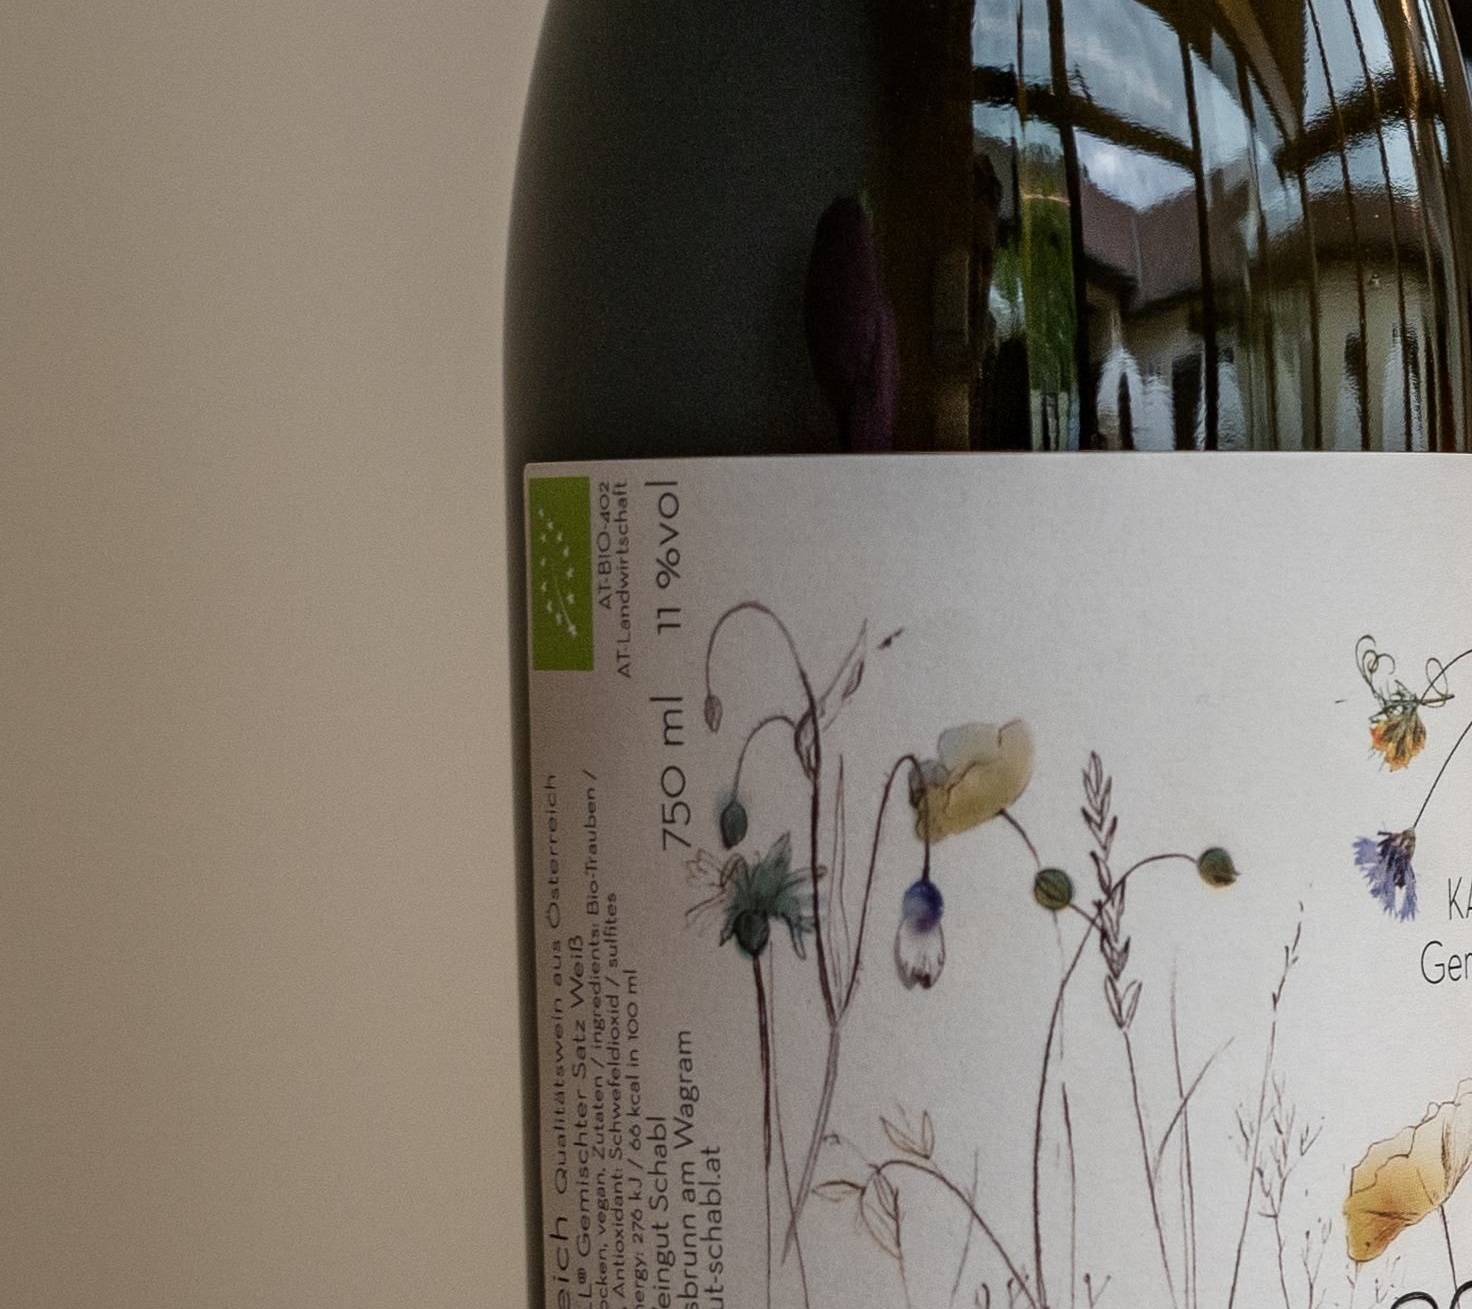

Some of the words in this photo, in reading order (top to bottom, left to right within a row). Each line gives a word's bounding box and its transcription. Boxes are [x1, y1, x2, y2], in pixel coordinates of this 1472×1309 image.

[597, 480, 612, 610] AT-BIO-402
[644, 480, 681, 589] %vol
[613, 480, 631, 679] AT-Landwirtschaft
[657, 606, 681, 635] 11
[649, 696, 684, 747] ml
[582, 768, 597, 781] /
[660, 765, 691, 852] 750
[545, 774, 561, 929] Österreich
[584, 787, 600, 915] Bio-Trauben
[551, 939, 563, 987] aus
[603, 892, 619, 968] sulfites
[568, 934, 585, 1009] Weiß
[588, 922, 605, 1050] ingredients:
[605, 975, 620, 988] /
[622, 969, 638, 994] ml
[571, 1018, 588, 1080] Satz
[626, 1001, 640, 1041] 100
[590, 1056, 605, 1069] /
[605, 994, 623, 1160] Schwefeldioxid
[625, 1049, 640, 1068] in
[673, 1030, 700, 1149] Wagram
[550, 997, 569, 1195] Qualitätswein
[592, 1076, 606, 1160] Zutaten
[625, 1075, 641, 1117] kcal
[626, 1124, 642, 1152] 66
[627, 1158, 642, 1170] /
[646, 1116, 669, 1213] Schabl
[574, 1090, 592, 1258] Gemischter
[627, 1177, 643, 1201] kJ
[680, 1161, 696, 1204] am
[610, 1168, 626, 1299] Antioxidant:
[630, 1208, 645, 1245] 276
